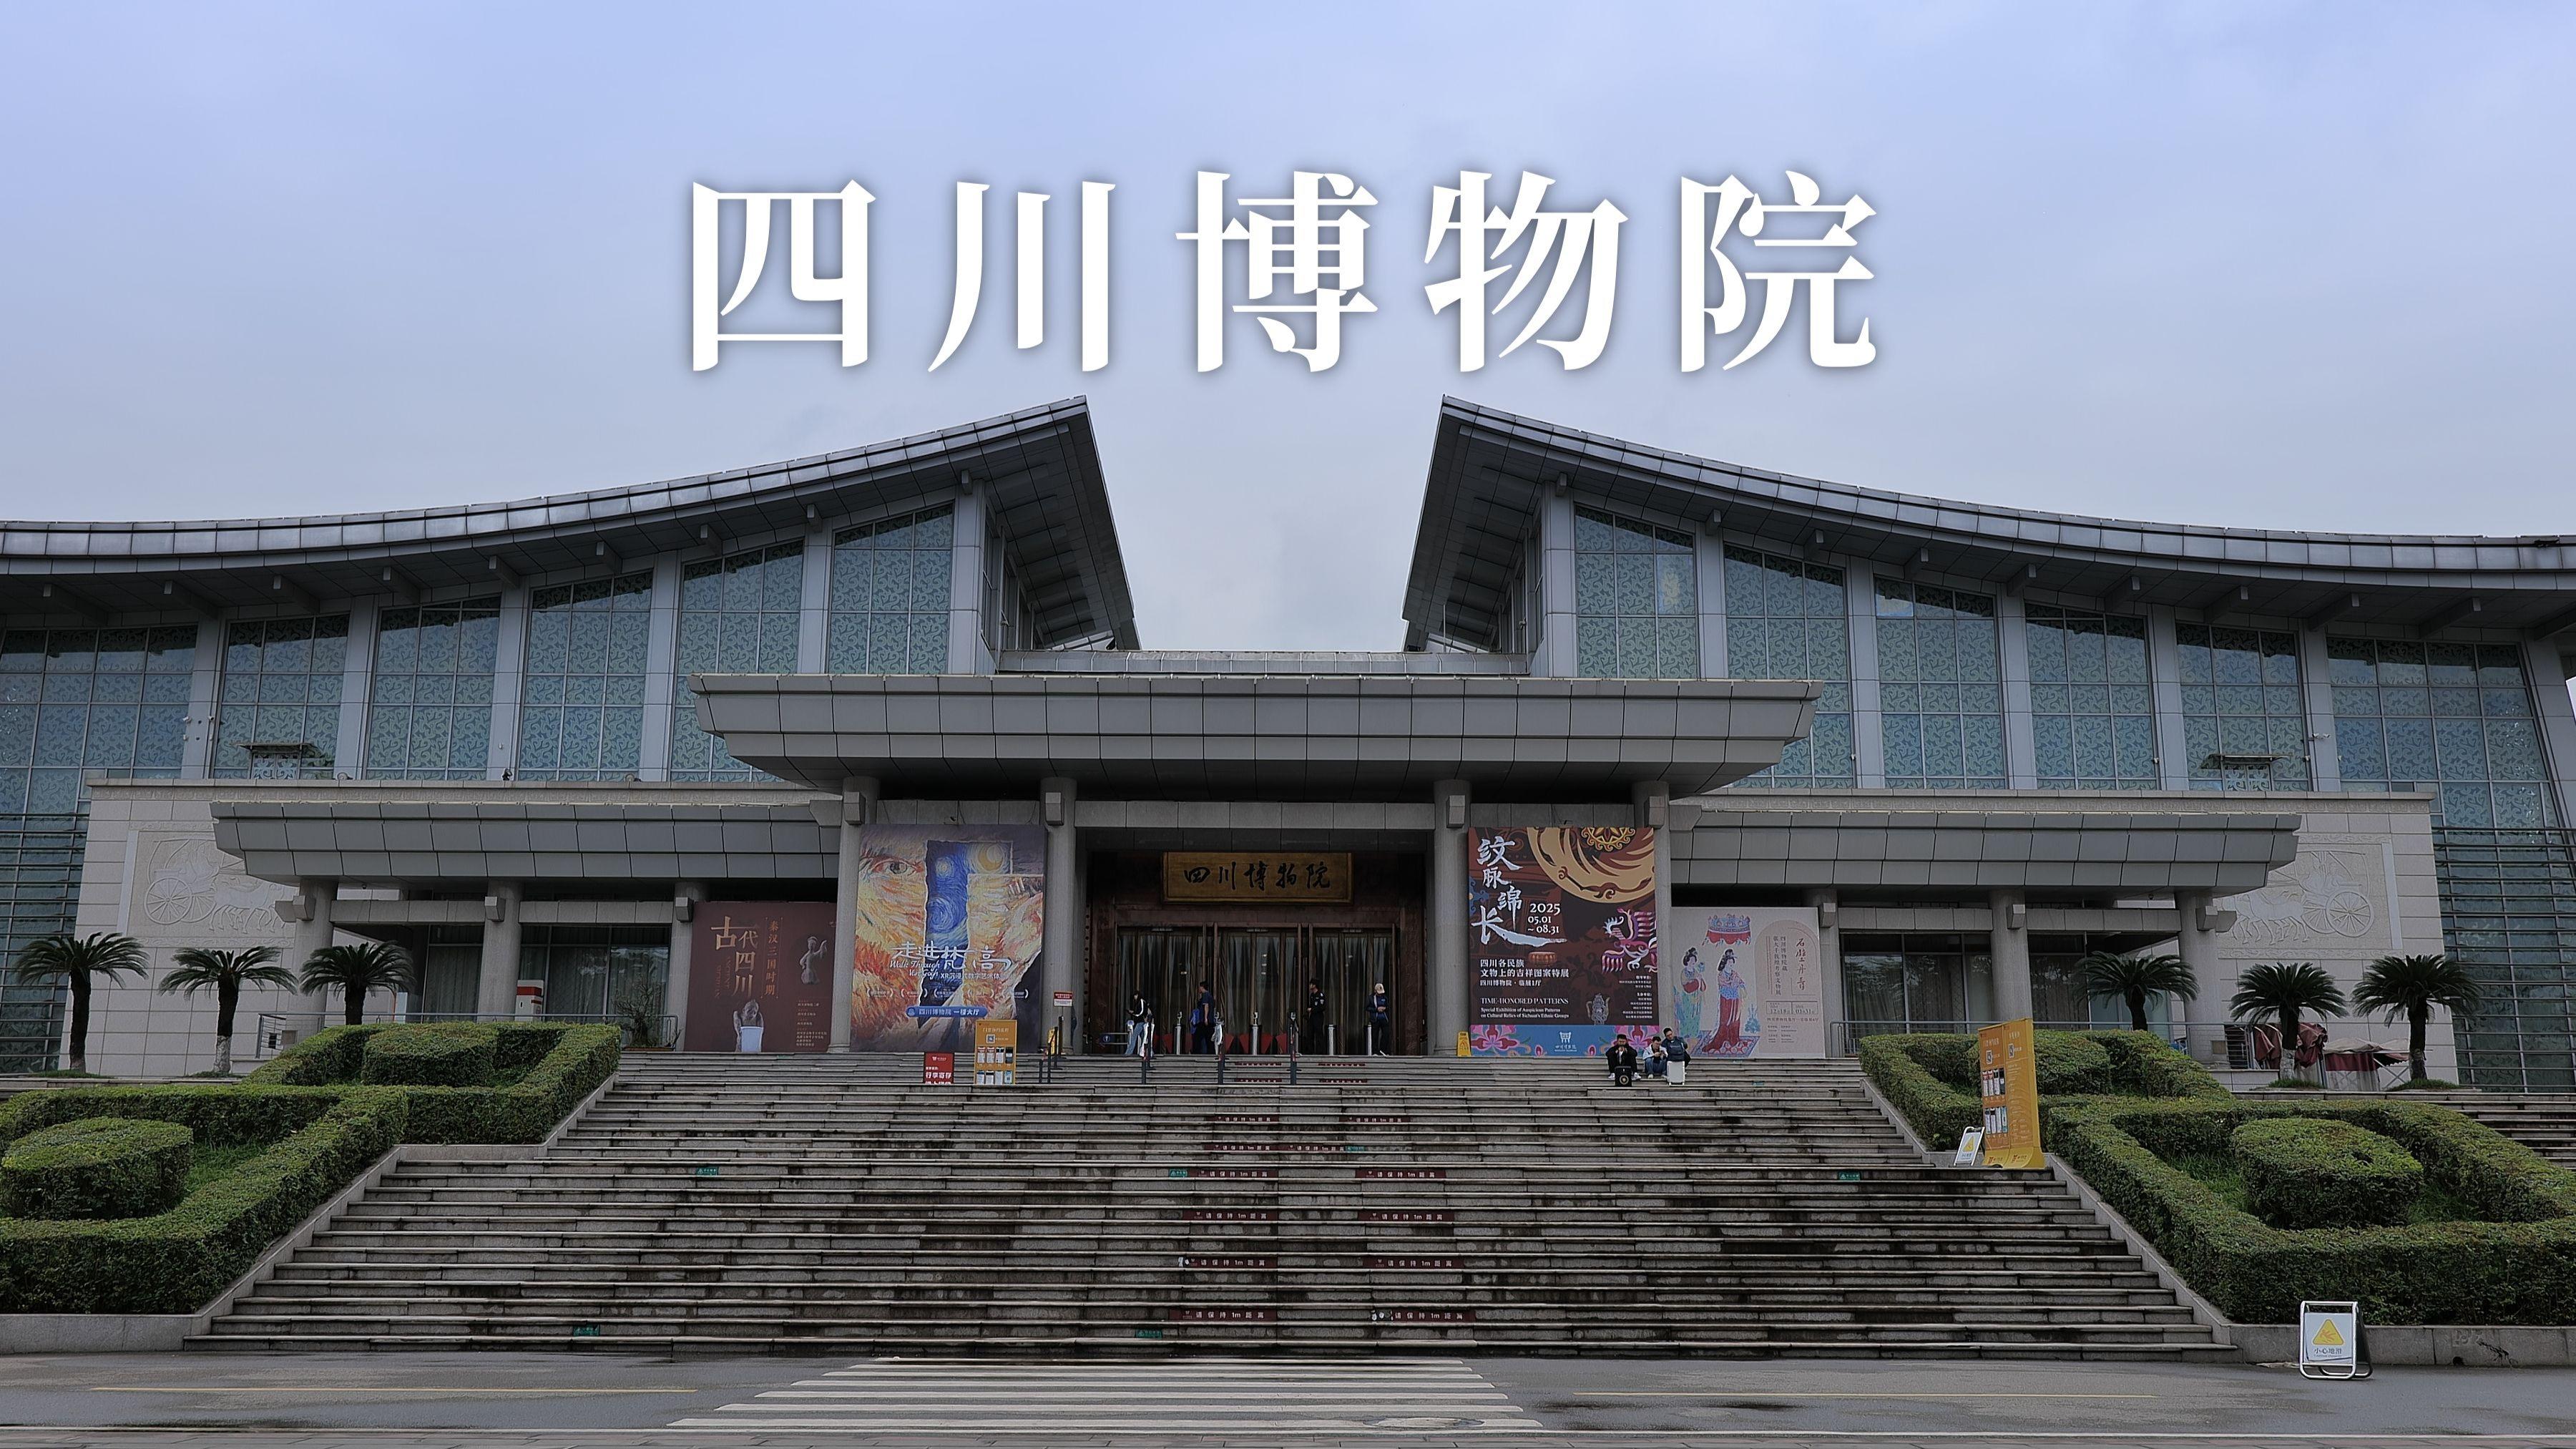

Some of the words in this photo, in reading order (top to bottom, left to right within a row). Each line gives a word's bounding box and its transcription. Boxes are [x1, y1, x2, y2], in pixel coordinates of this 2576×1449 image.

[1183, 860, 1331, 891] 四川博物院
[1471, 836, 1568, 947] 纹脉绵长
[1527, 916, 1551, 925] 05.01
[1529, 903, 1561, 915] 2025
[711, 916, 760, 998] 古代四川
[764, 920, 780, 996] 秦汉三国时期
[889, 941, 1012, 971] 走进梵高
[1480, 959, 1524, 967] 四川各民族
[1480, 968, 1569, 978] 文物上的吉祥图案特展
